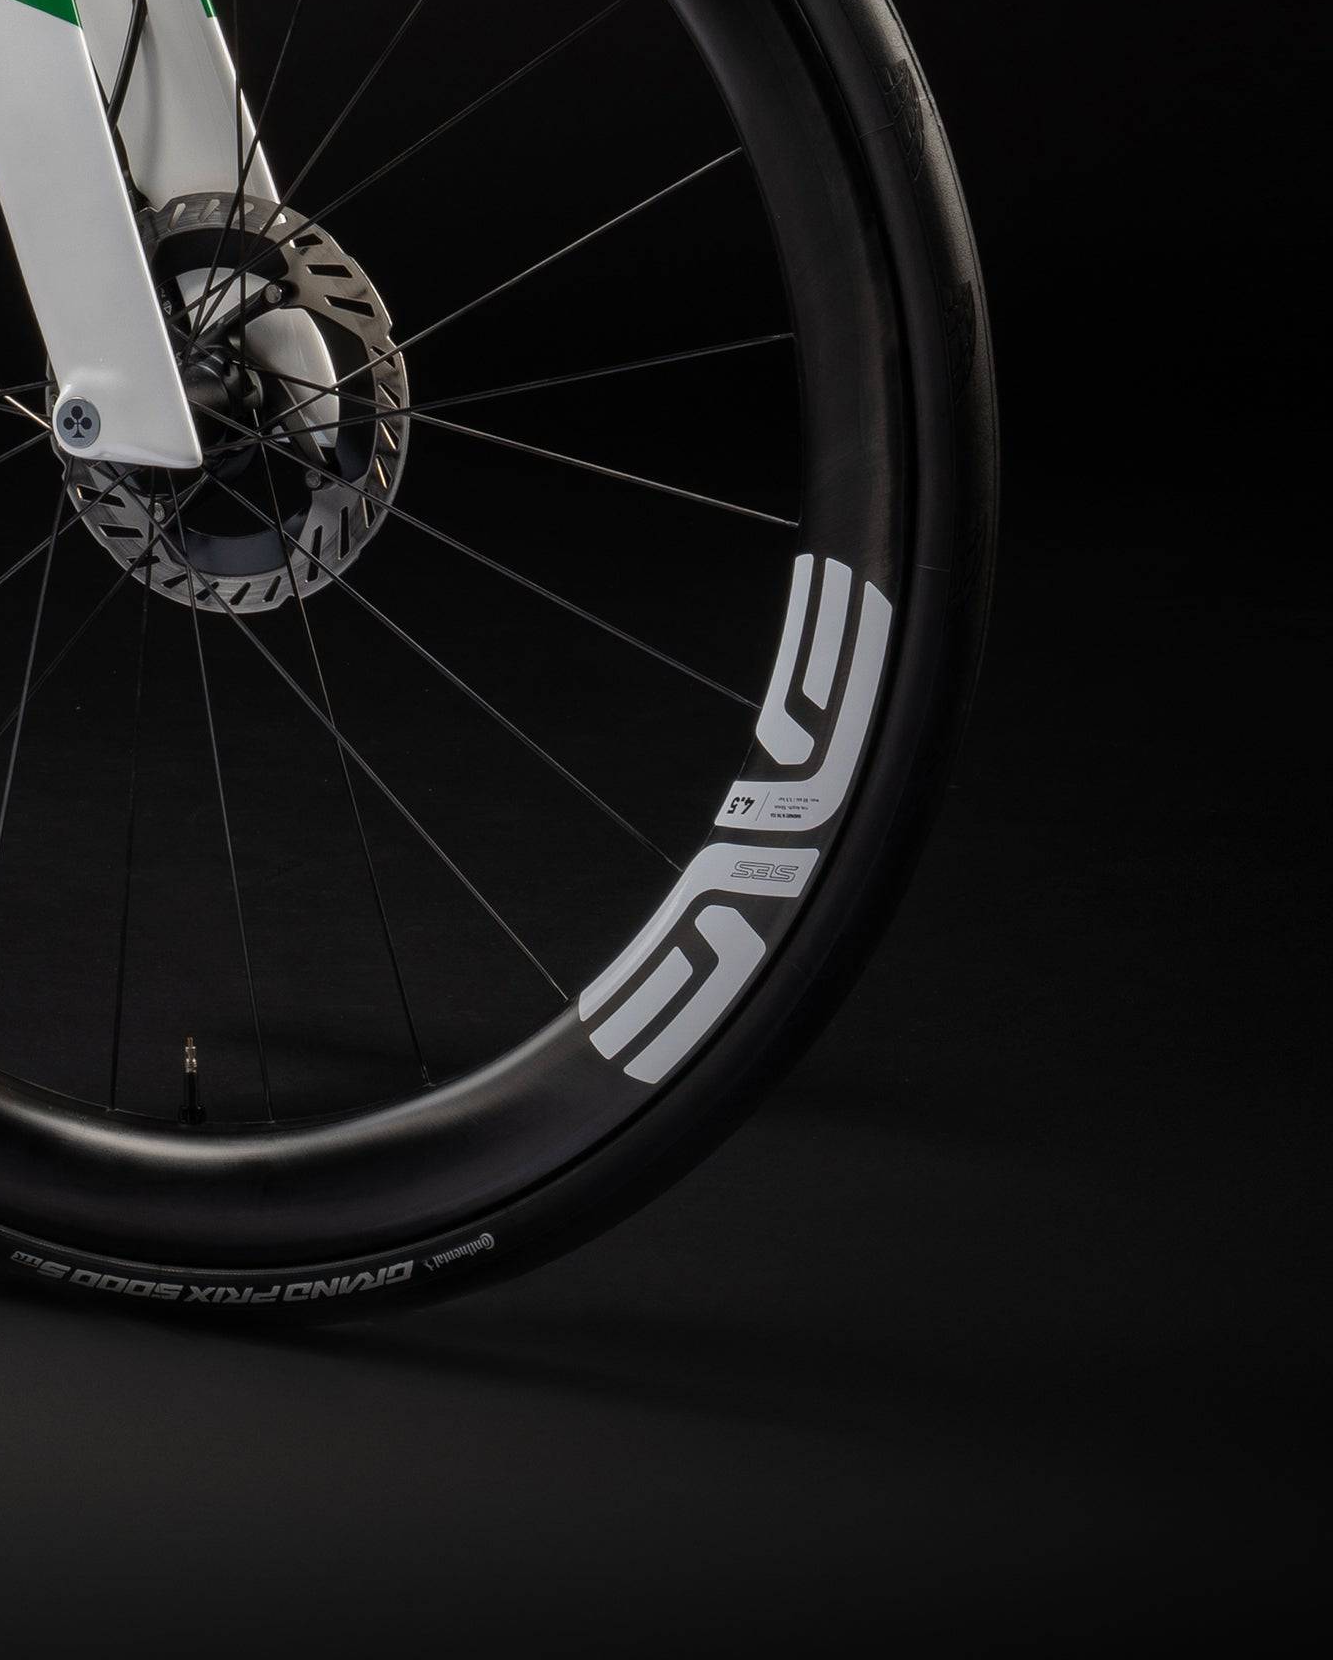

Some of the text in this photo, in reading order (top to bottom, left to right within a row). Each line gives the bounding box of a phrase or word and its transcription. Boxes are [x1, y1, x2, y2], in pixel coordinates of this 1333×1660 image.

[726, 796, 756, 815] 4.5
[431, 1232, 495, 1271] Continental
[68, 1268, 185, 1300] 5000
[187, 1281, 284, 1305] PRIX
[283, 1258, 415, 1302] GRAND
